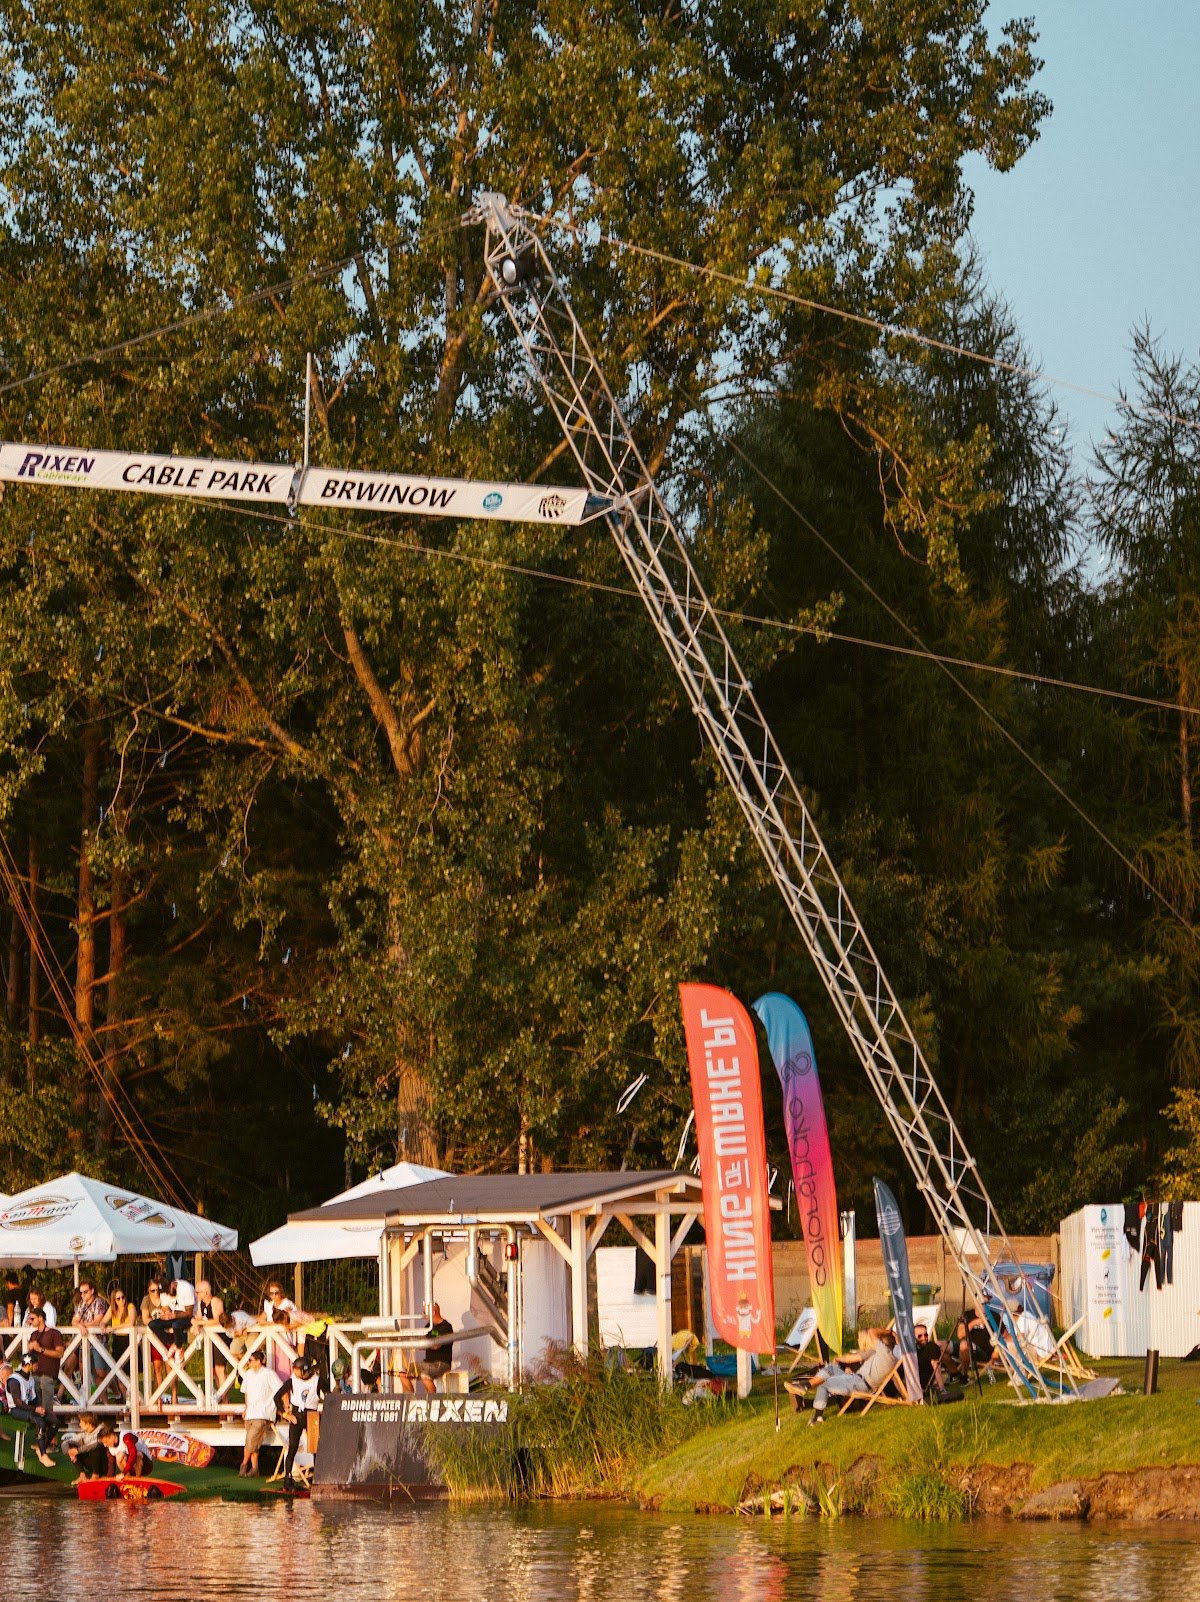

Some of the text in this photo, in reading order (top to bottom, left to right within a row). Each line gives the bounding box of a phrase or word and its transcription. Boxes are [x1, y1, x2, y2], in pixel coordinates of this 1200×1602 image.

[17, 452, 96, 477] RIXEN
[122, 464, 277, 493] CABLE PARK
[320, 478, 456, 508] BRWINOW
[341, 1400, 401, 1411] RIDING WATER
[351, 1410, 377, 1422] SINCE
[407, 1400, 508, 1422] RIXEN
